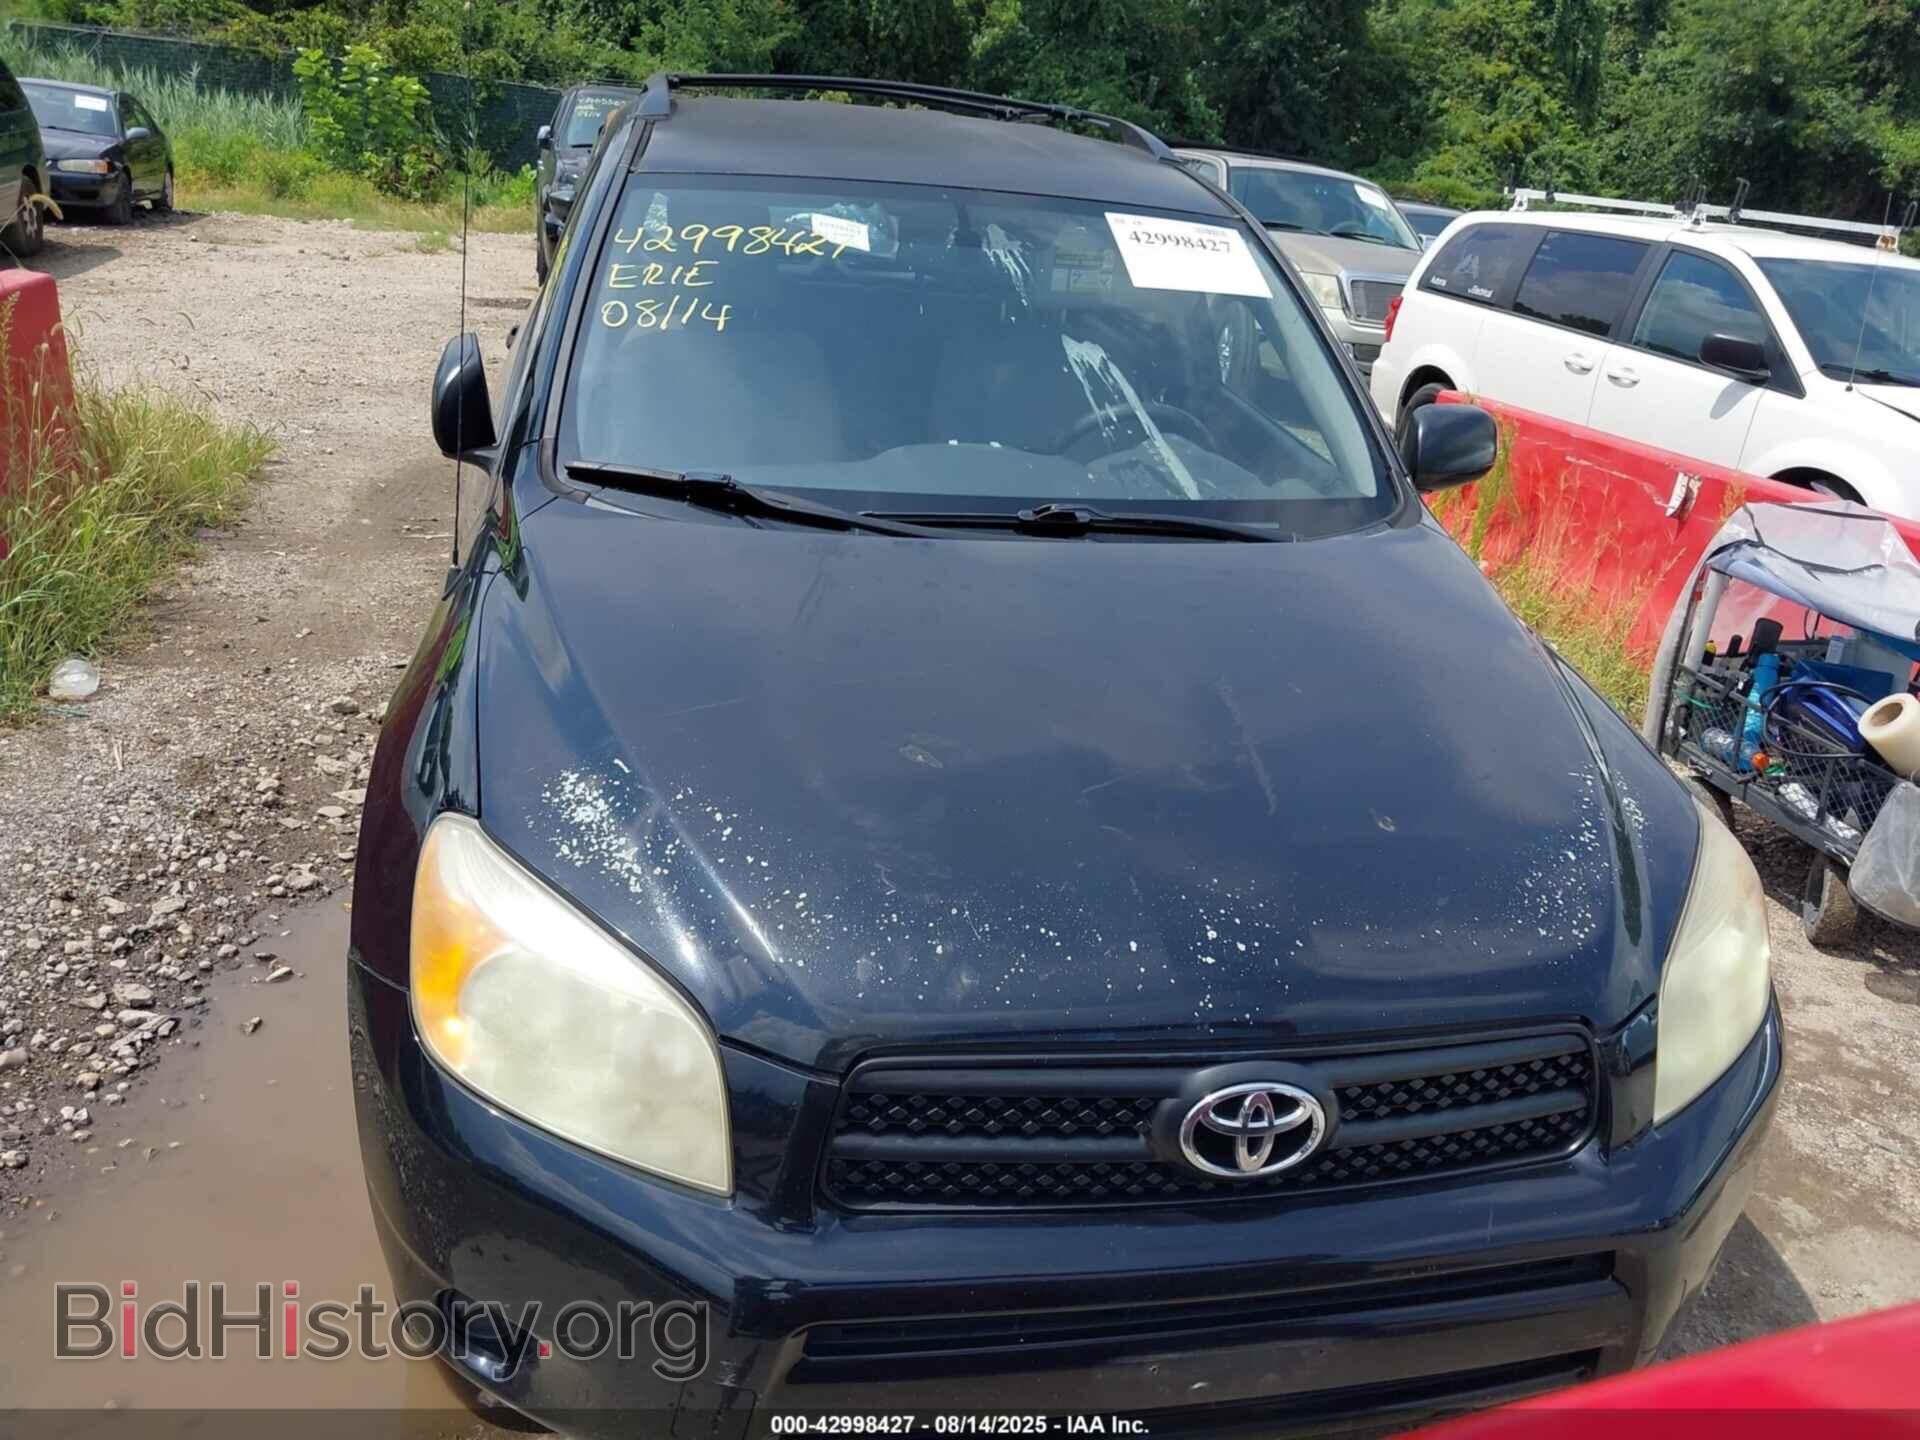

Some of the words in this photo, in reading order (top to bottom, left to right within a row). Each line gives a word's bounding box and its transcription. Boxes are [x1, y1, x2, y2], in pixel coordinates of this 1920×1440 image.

[1128, 230, 1231, 254] 42998427
[608, 260, 720, 289] ERIE
[600, 294, 734, 332] 08/14
